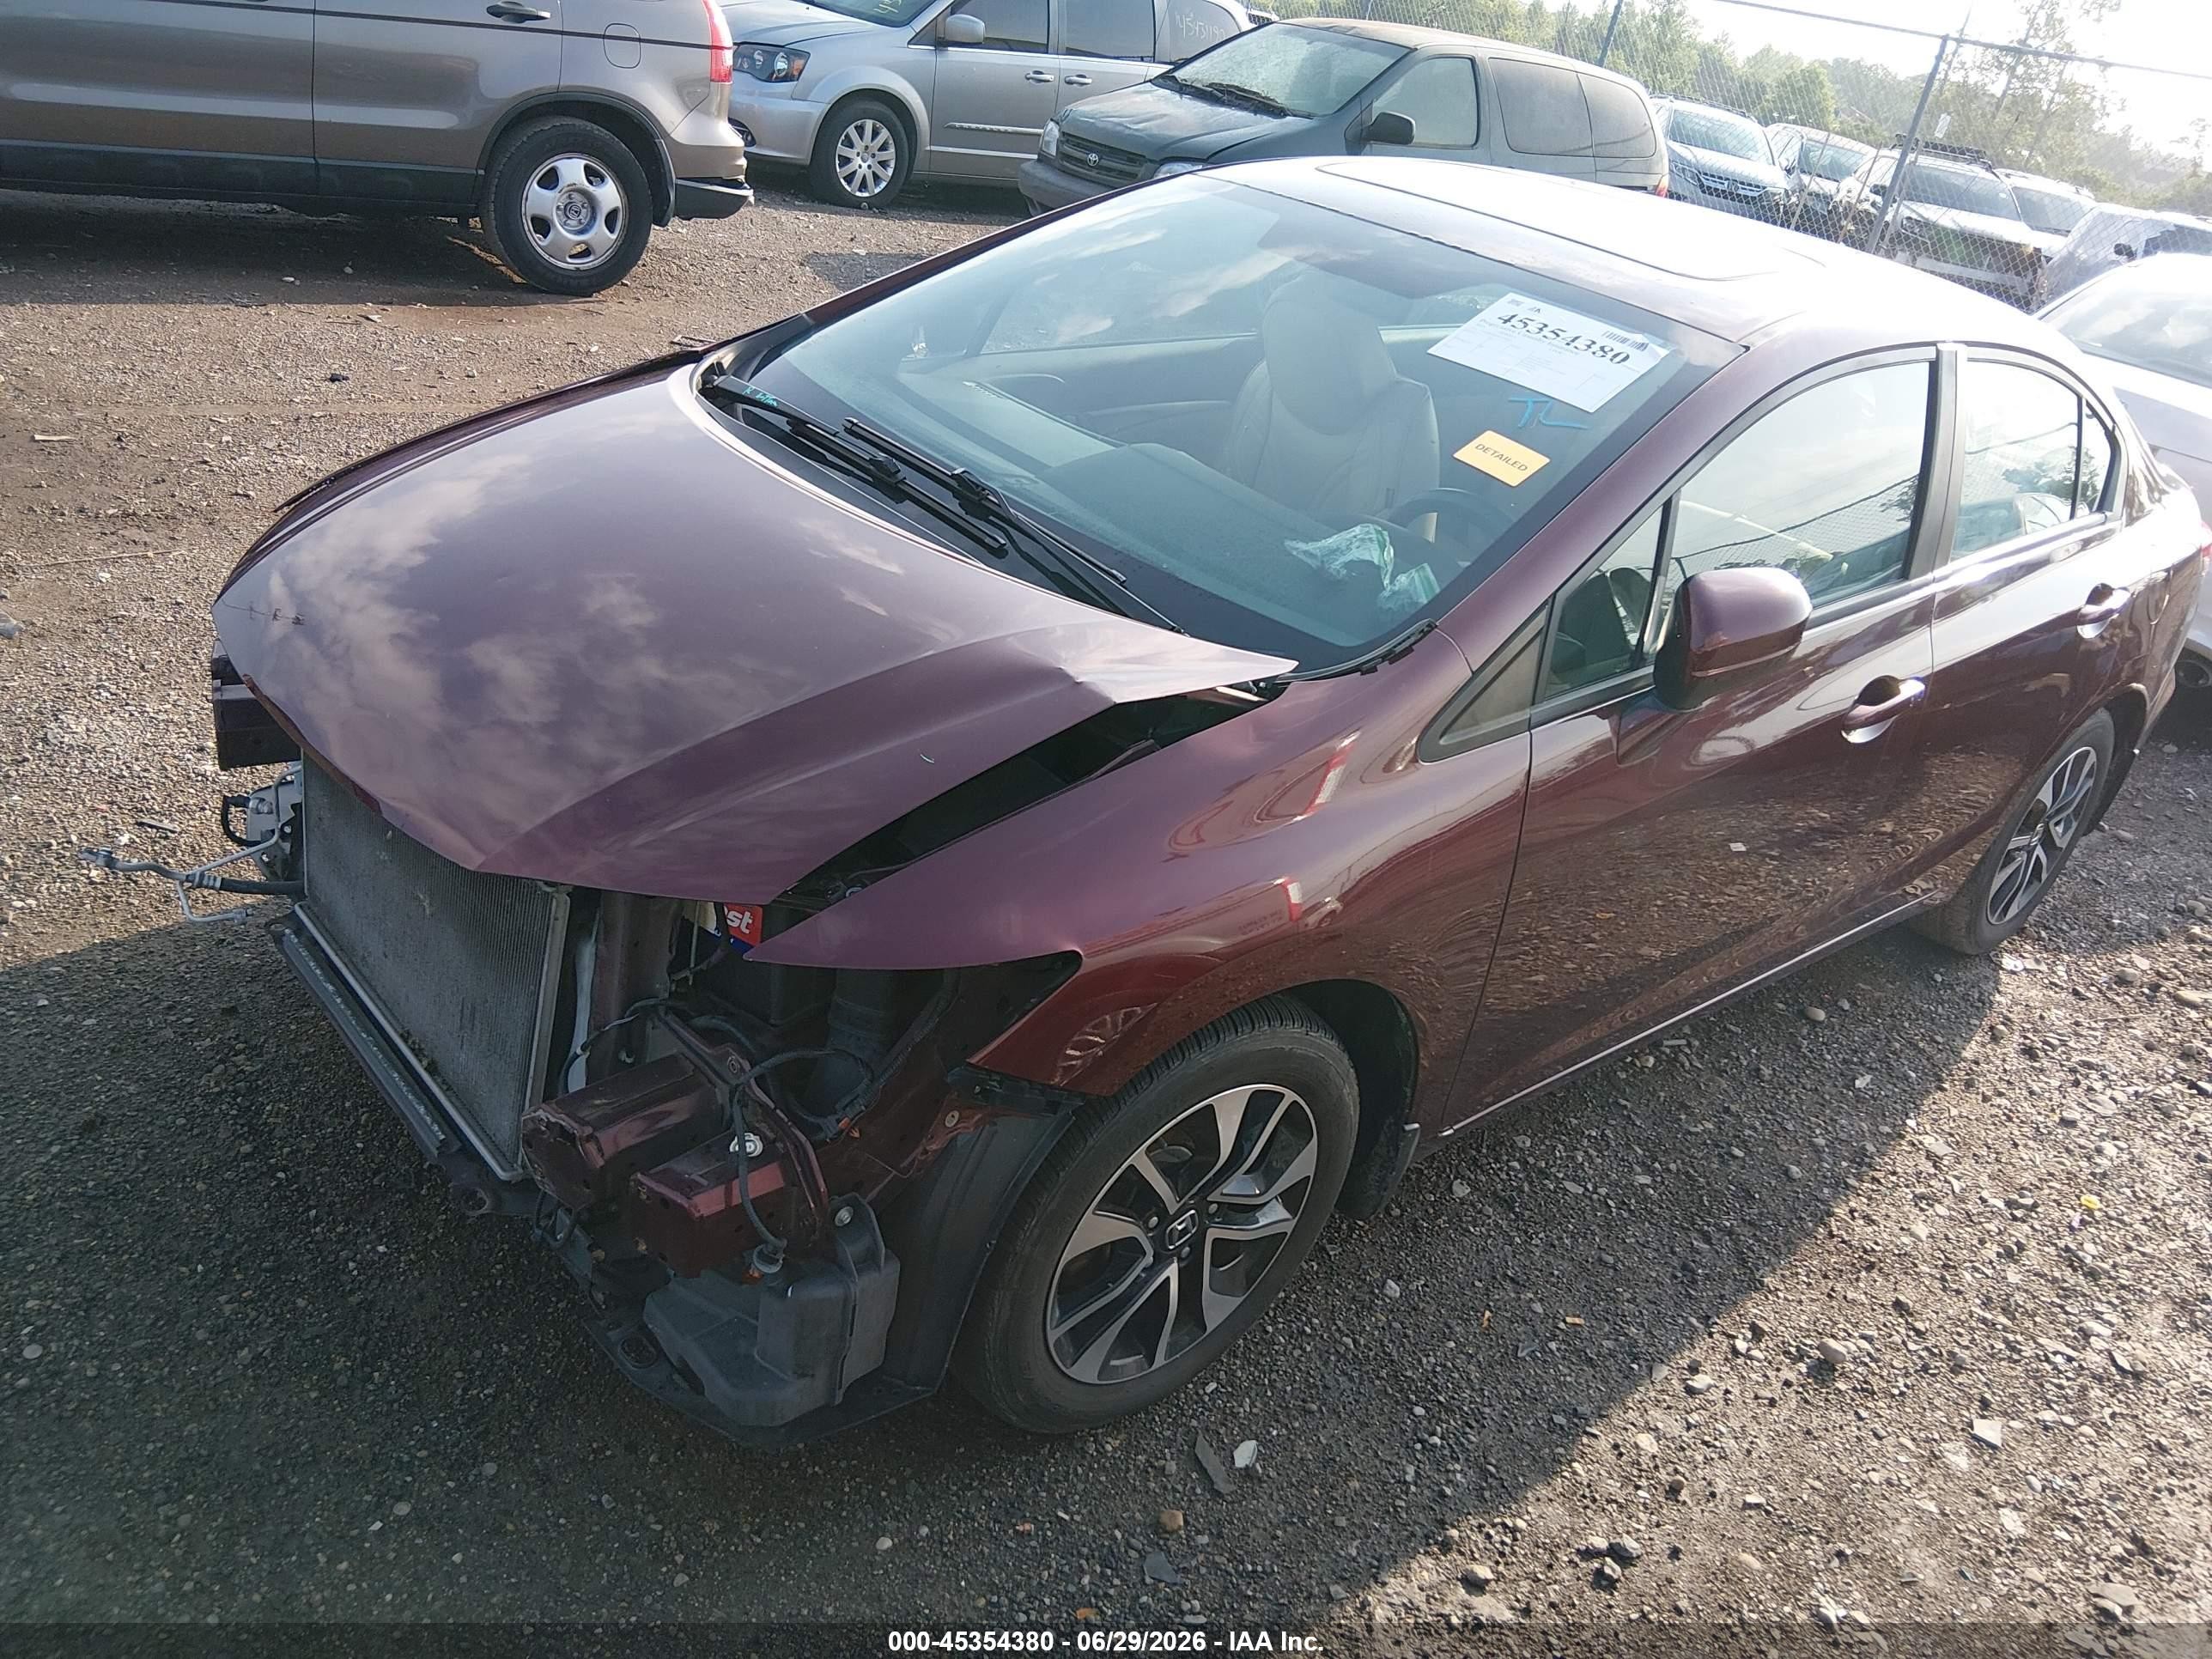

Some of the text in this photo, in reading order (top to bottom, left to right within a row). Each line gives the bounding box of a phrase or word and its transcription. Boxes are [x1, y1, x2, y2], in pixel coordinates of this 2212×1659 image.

[1497, 313, 1631, 365] 45354380
[1474, 443, 1528, 471] DETAILED
[723, 905, 753, 934] st
